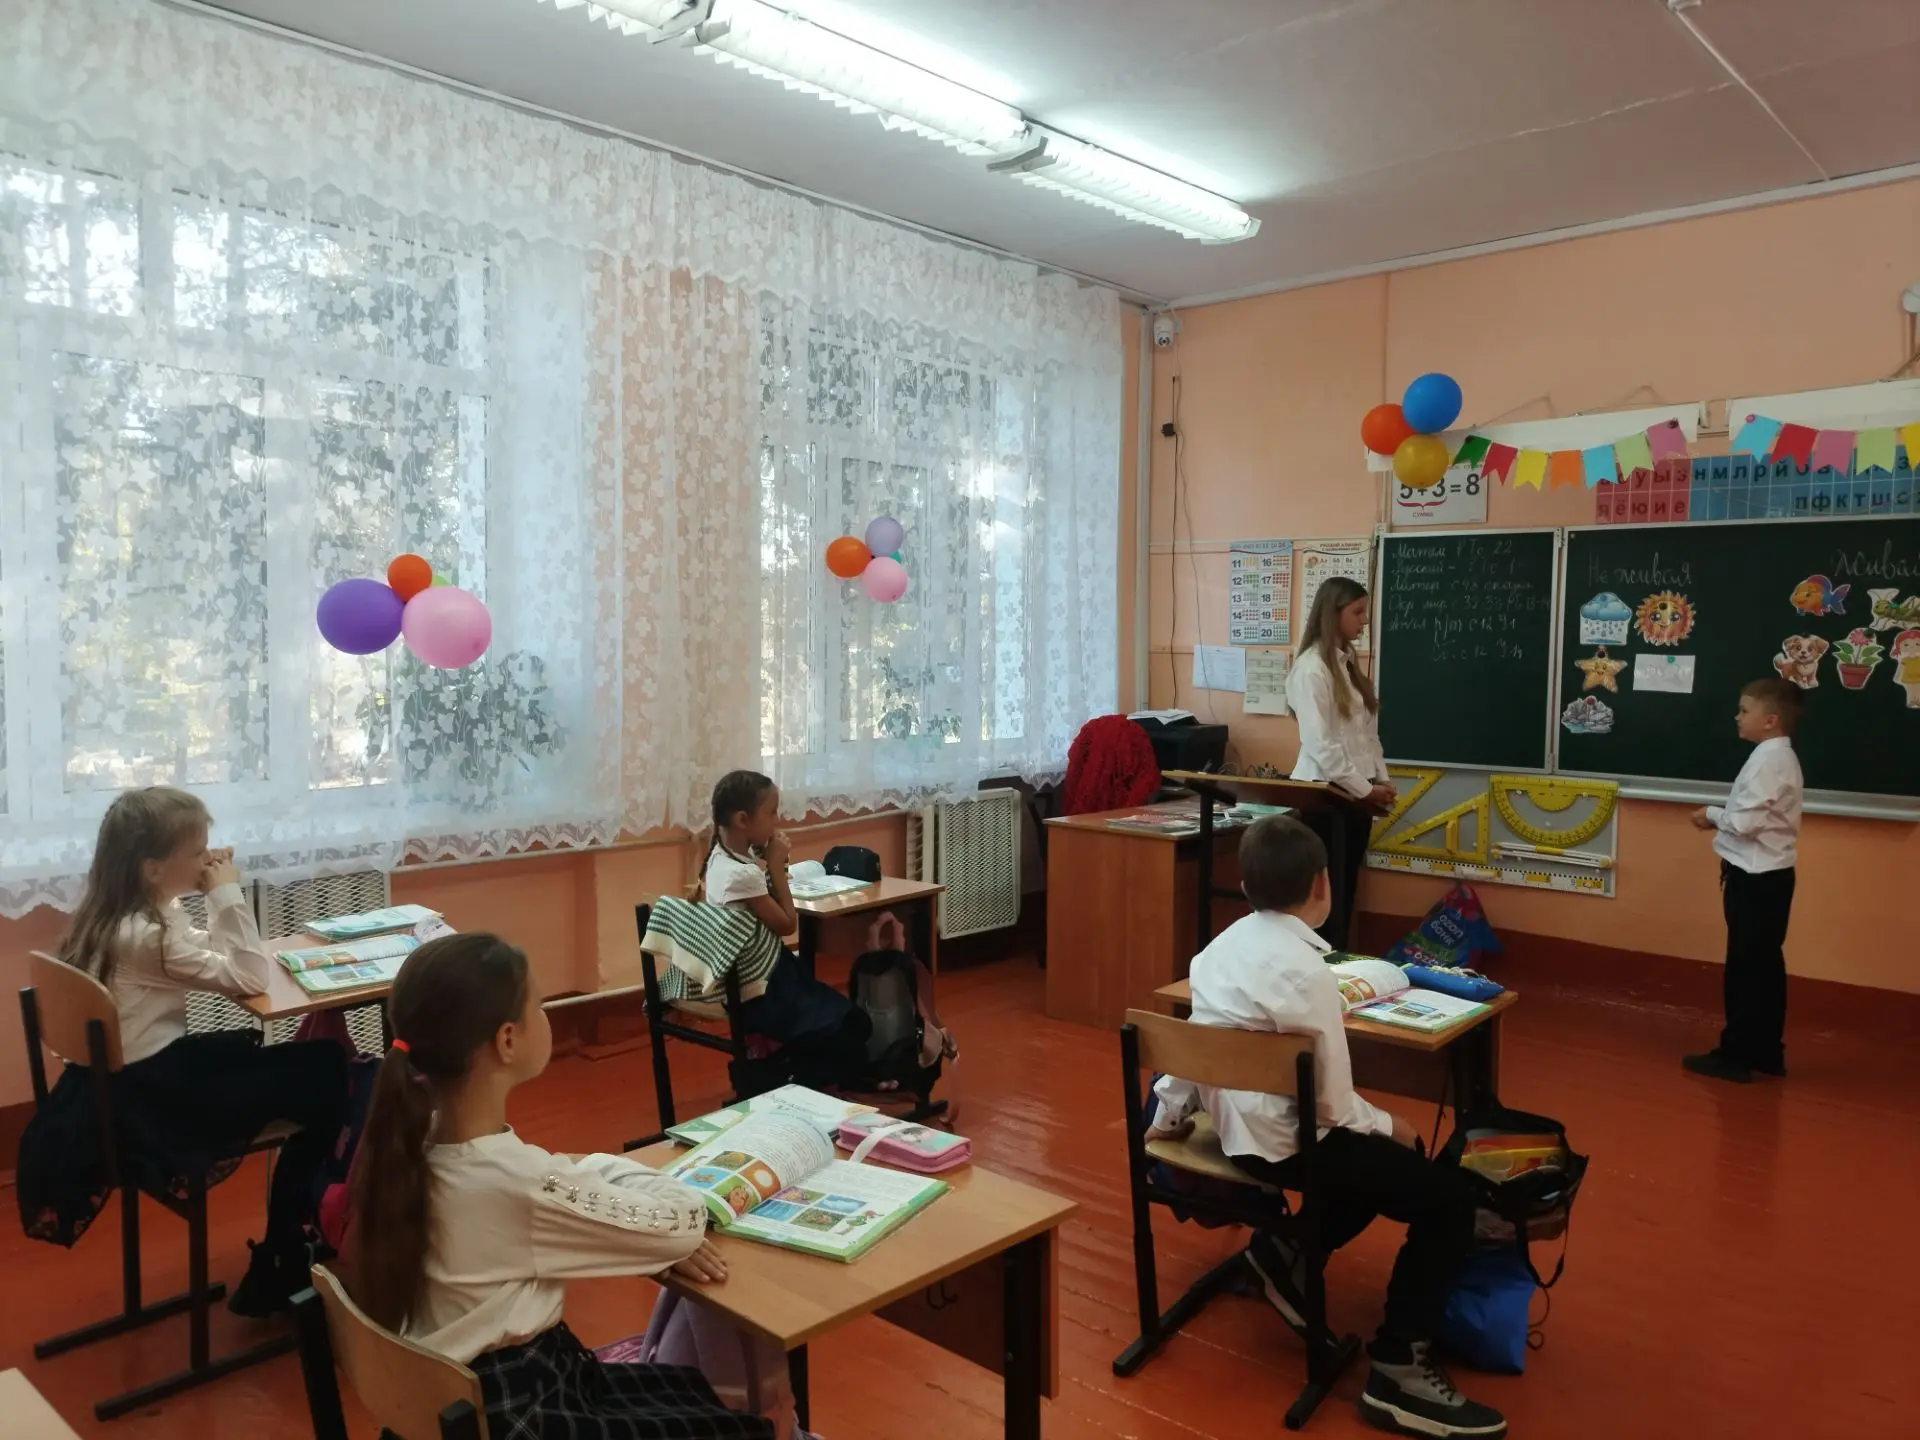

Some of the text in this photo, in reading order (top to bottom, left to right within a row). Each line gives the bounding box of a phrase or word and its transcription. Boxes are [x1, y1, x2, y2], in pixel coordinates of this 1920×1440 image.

[1232, 559, 1272, 568] 11 16
[1232, 576, 1272, 585] 12 17
[1232, 594, 1272, 602] 13 18
[1232, 611, 1272, 619] 14 19
[1232, 628, 1272, 637] 15 20
